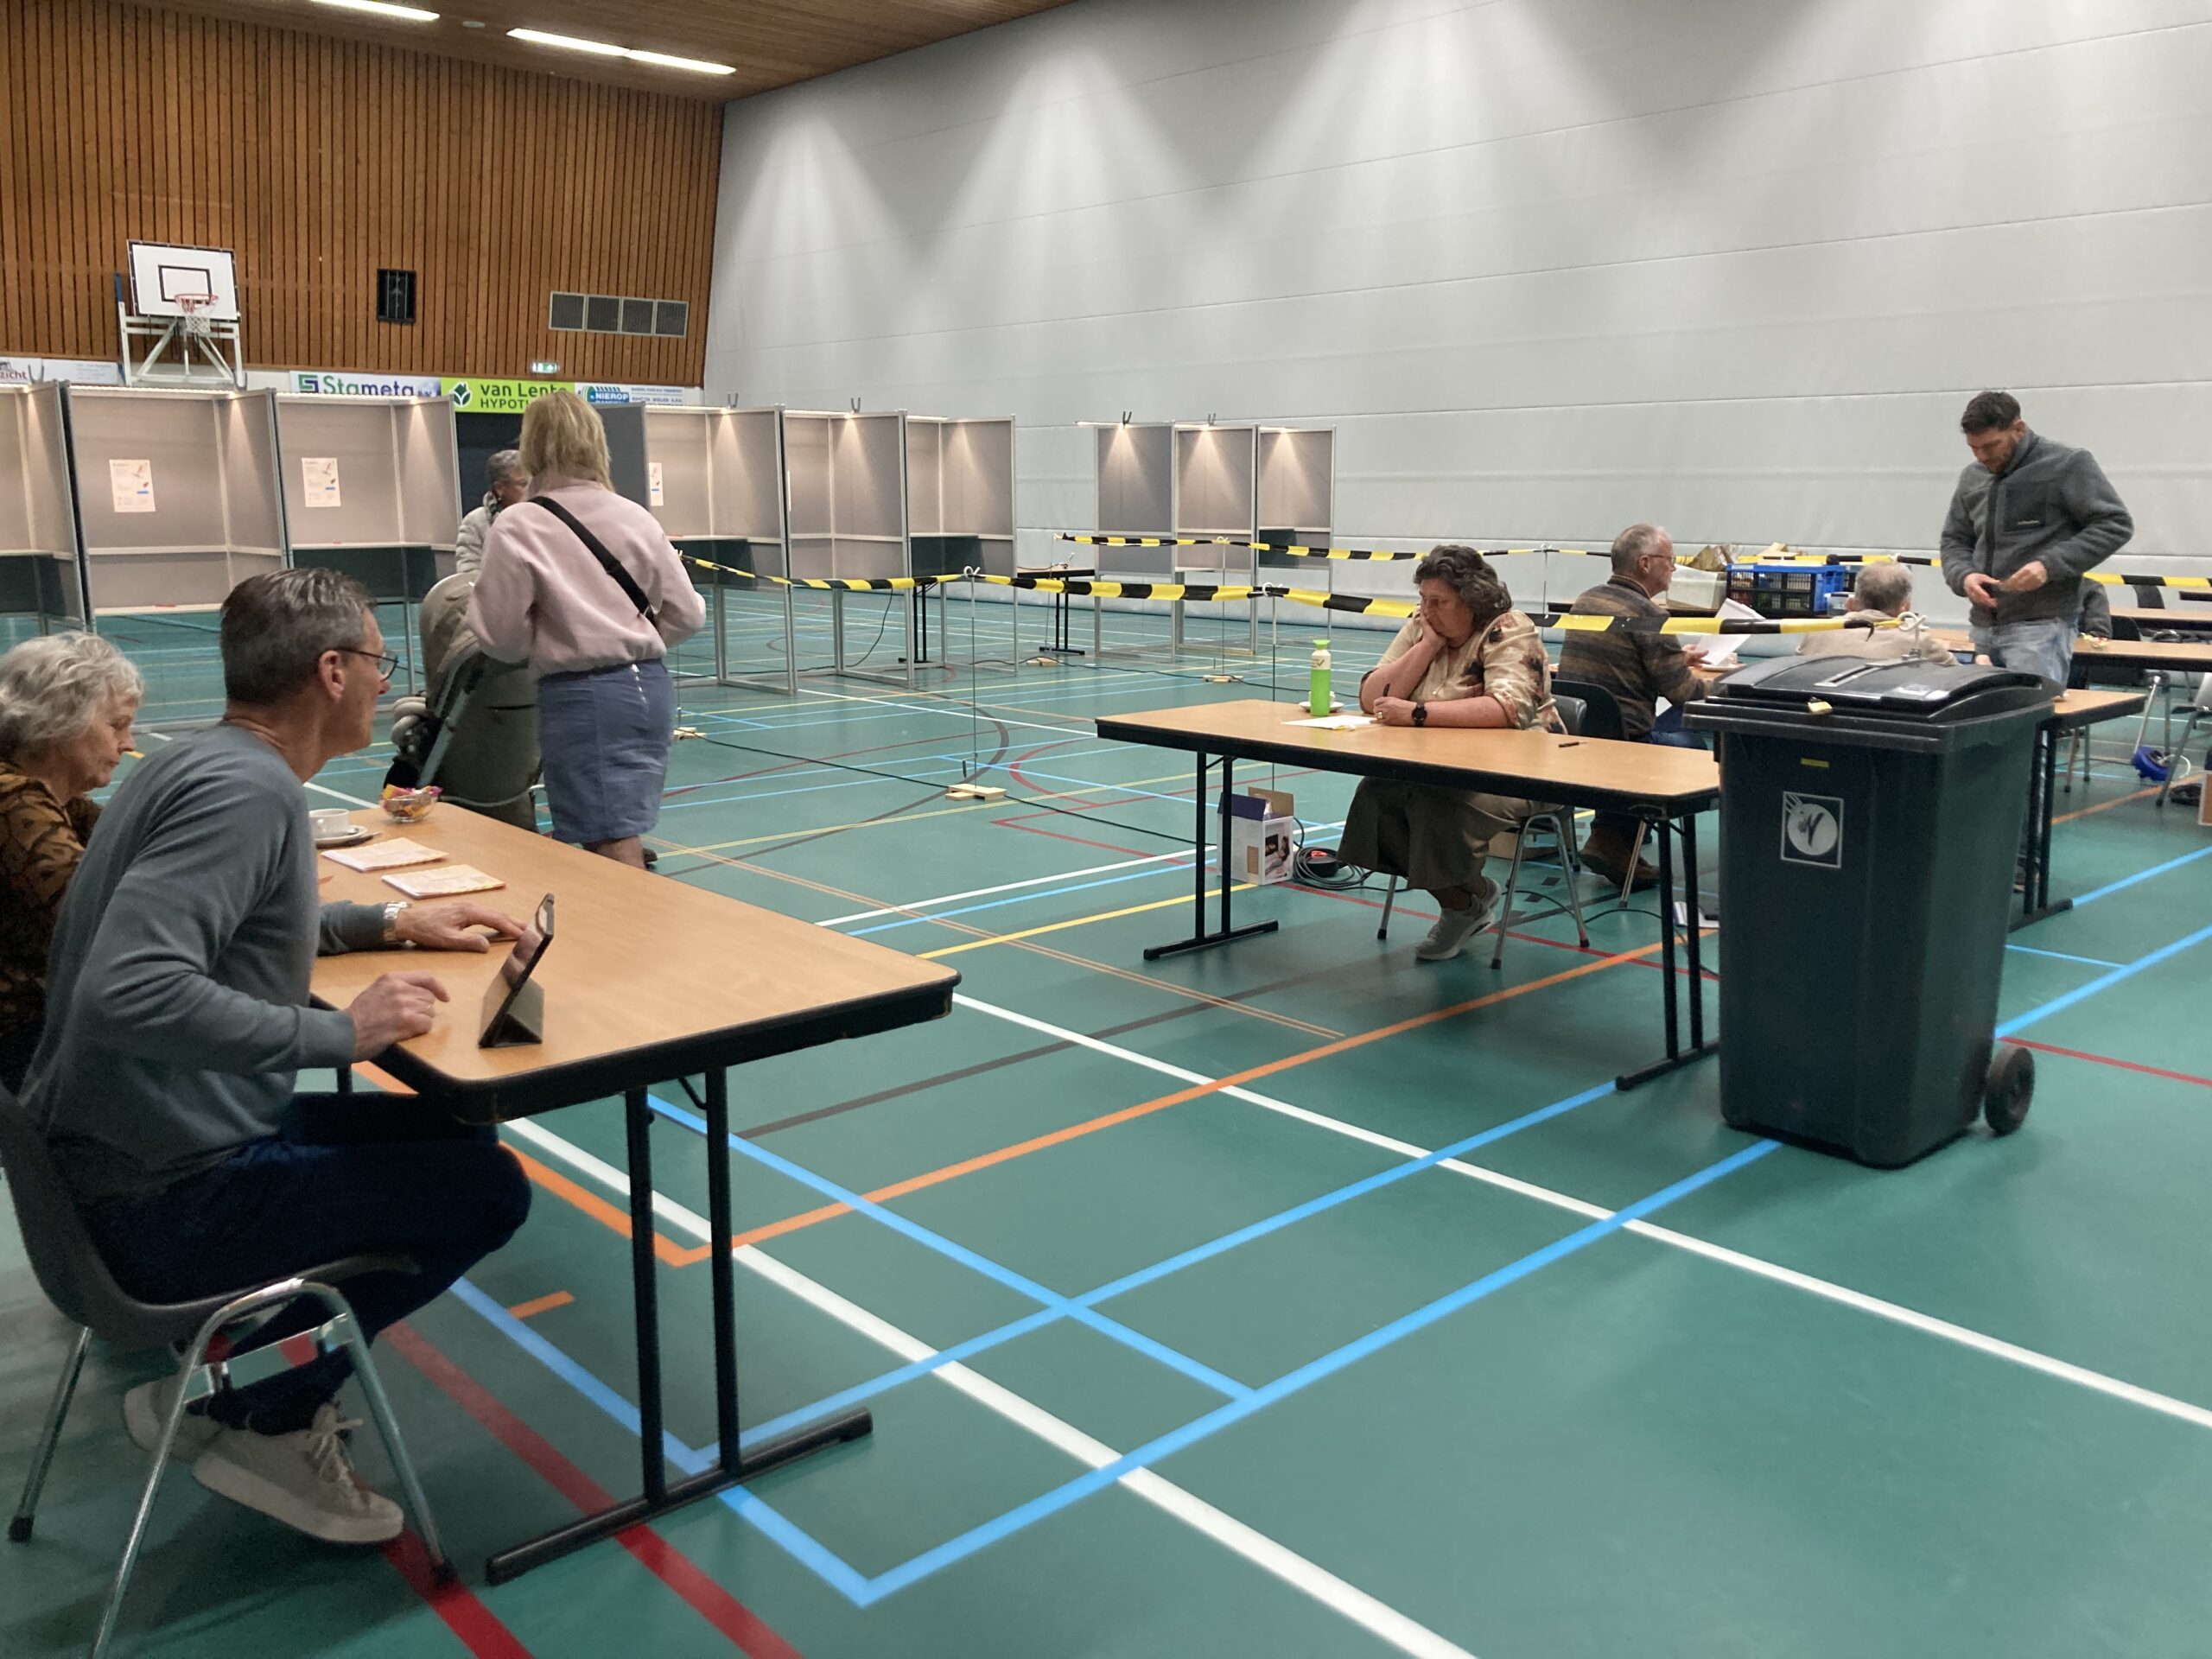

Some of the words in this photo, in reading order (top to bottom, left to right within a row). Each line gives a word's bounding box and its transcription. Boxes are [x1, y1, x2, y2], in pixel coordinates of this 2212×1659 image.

[323, 375, 414, 396] Stameta
[480, 384, 512, 396] van
[480, 398, 529, 409] HYPOT
